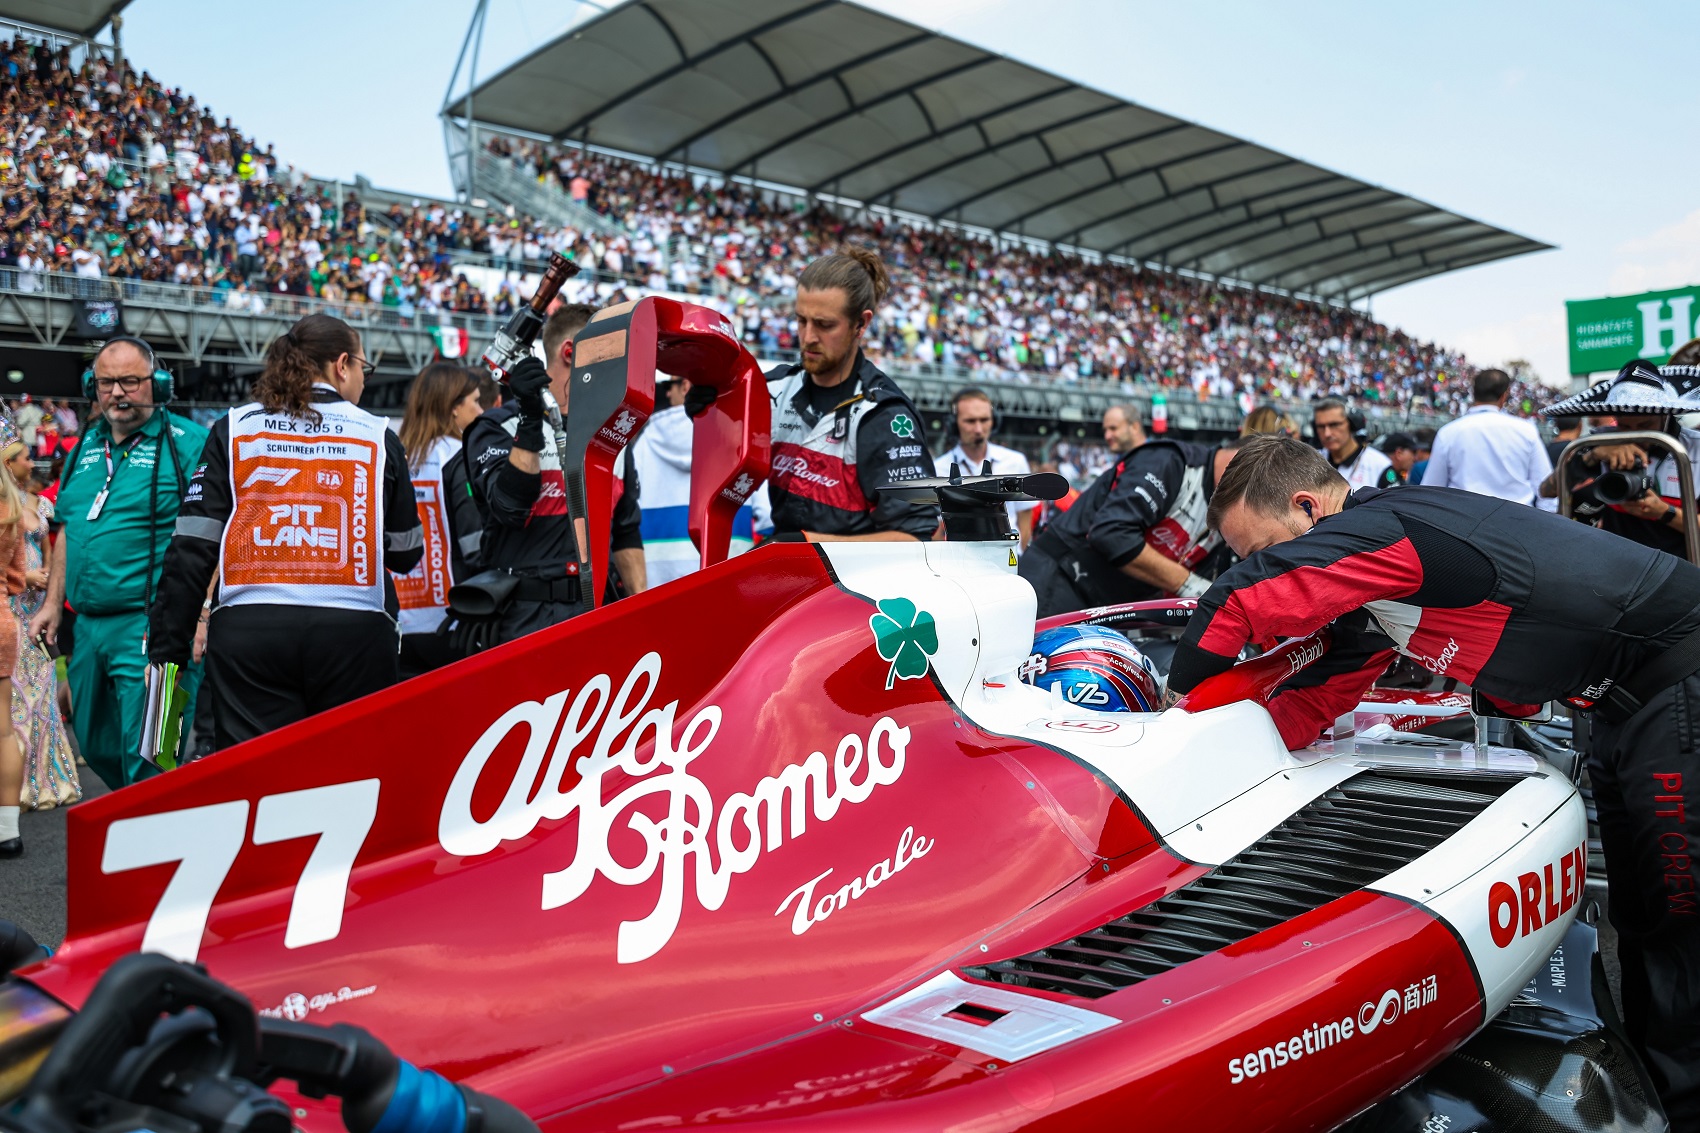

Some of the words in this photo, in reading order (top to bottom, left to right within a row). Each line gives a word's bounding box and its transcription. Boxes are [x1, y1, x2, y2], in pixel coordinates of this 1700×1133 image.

[1576, 320, 1634, 335] HIDRATATE
[1637, 294, 1700, 358] H
[1577, 335, 1634, 350] SANAMENTE
[265, 419, 297, 432] MEX
[304, 423, 330, 434] 205
[335, 425, 343, 434] 9
[600, 427, 628, 445] SINGHA
[267, 444, 315, 455] SCRUTINEER
[316, 446, 325, 454] F1
[328, 446, 347, 455] TYRE
[899, 445, 922, 453] ADLER
[241, 466, 302, 489] F1
[316, 473, 341, 486] FIA
[772, 454, 798, 477] Alfa
[794, 457, 840, 487] Romeo
[888, 466, 915, 477] WEB
[888, 474, 927, 483] EYEWEAR
[353, 463, 368, 539] MEXICO
[721, 488, 746, 503] SINGHA
[268, 504, 322, 525] PIT
[253, 526, 338, 549] LANE
[426, 505, 443, 569] MEXICO
[353, 541, 368, 584] CITY
[431, 569, 445, 605] CITY
[1286, 637, 1324, 674] Hyland
[1581, 684, 1598, 698] PIT
[1591, 677, 1614, 699] CREW
[438, 651, 679, 910] Alfa
[600, 705, 912, 964] Romeo
[1653, 772, 1686, 824] PIT
[101, 778, 380, 964] 77
[775, 826, 934, 936] Tonale
[1658, 832, 1697, 915] CREW
[1488, 840, 1587, 949] ORLEN
[1550, 956, 1566, 987] MAPLE
[309, 992, 337, 1012] Alfa
[337, 985, 377, 1002] Romeo
[1404, 974, 1438, 1015] 商汤
[1229, 1016, 1354, 1084] sensetime
